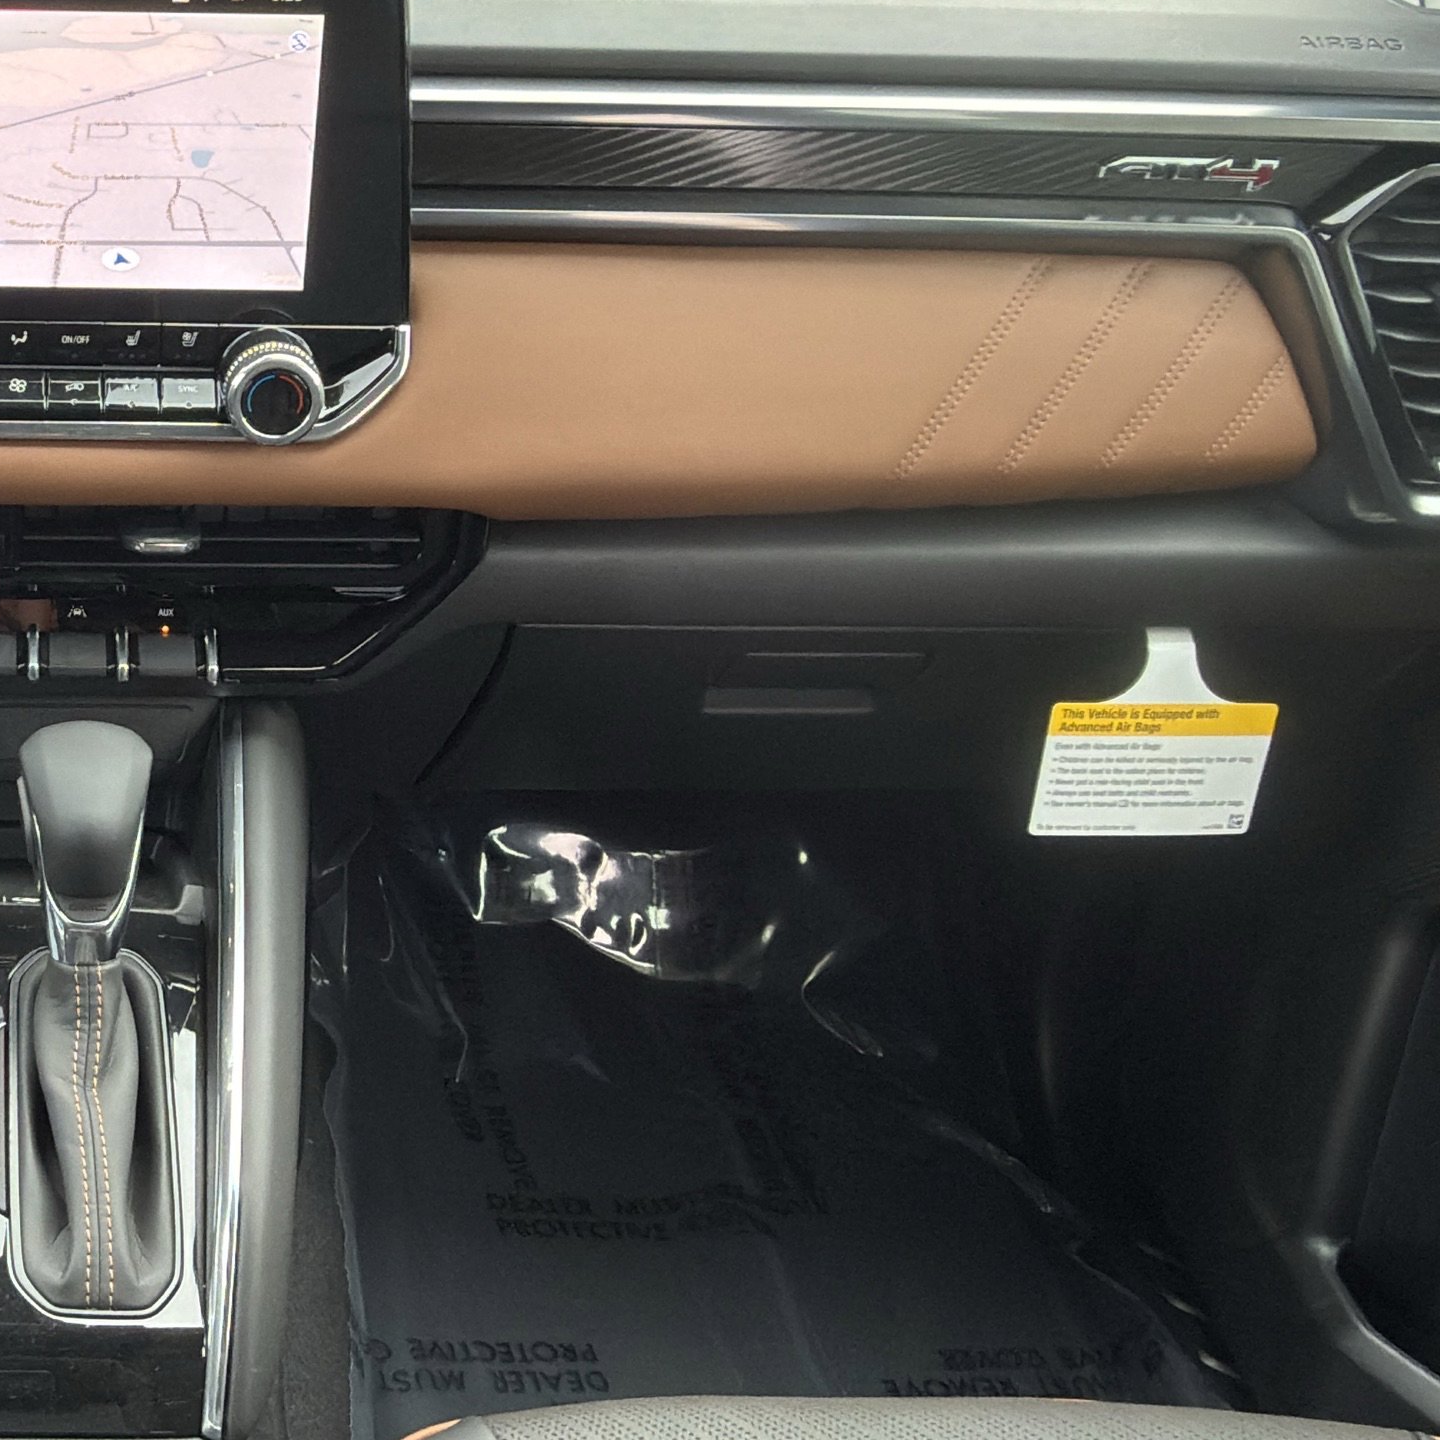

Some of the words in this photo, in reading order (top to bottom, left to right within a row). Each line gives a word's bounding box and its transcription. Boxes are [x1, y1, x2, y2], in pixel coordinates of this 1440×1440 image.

[1299, 35, 1405, 51] AIRBAG
[60, 334, 91, 346] ON/OFF
[177, 384, 199, 394] SYNC
[157, 608, 174, 618] AUX
[1061, 708, 1085, 720] This
[1087, 708, 1128, 720] Vehicle
[1142, 708, 1194, 722] Equipped
[1195, 708, 1221, 720] with
[1058, 721, 1115, 733] Advanced
[1116, 721, 1132, 733] Air
[1134, 721, 1162, 735] Bags
[405, 1338, 600, 1365] PROTECTIVE
[379, 1368, 467, 1393] MUST
[494, 1368, 610, 1393] DEALER
